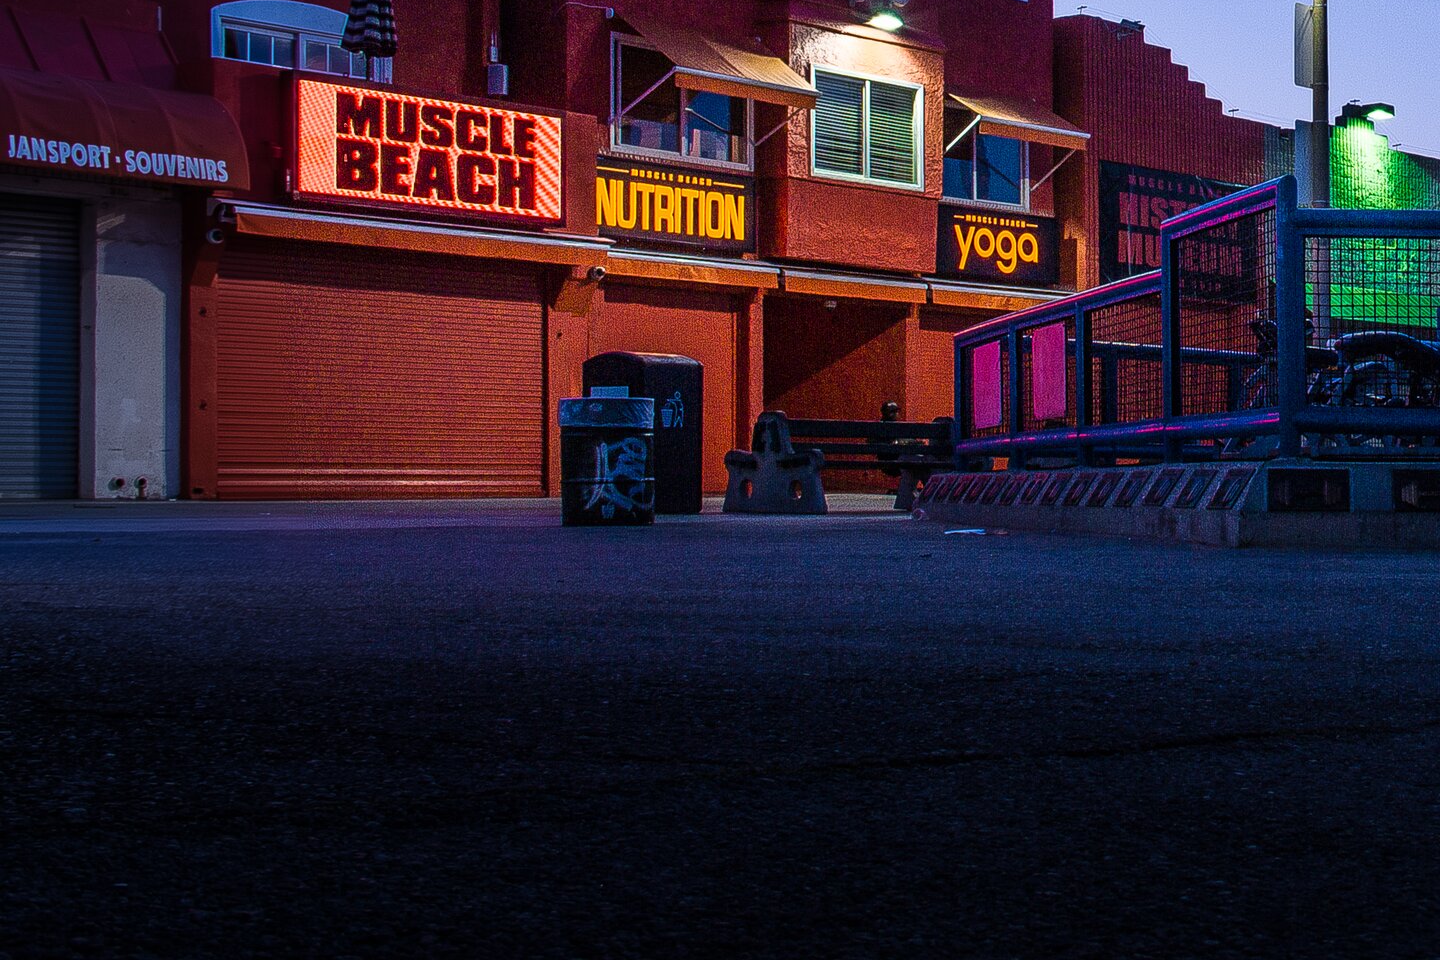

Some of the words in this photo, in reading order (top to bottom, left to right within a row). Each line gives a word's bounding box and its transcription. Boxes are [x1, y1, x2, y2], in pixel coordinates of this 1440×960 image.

[336, 92, 535, 158] MUSCLE
[8, 134, 111, 169] JANSPORT
[124, 149, 229, 183] SOUVENIRS
[336, 139, 535, 210] BEACH
[630, 168, 674, 182] MUSCLE
[677, 174, 712, 187] BEACH
[595, 177, 745, 240] NUTRITION
[965, 214, 998, 225] MUSCLE
[999, 218, 1026, 228] BEACH
[954, 224, 1039, 274] yoga
[1117, 230, 1244, 278] MUEUM
